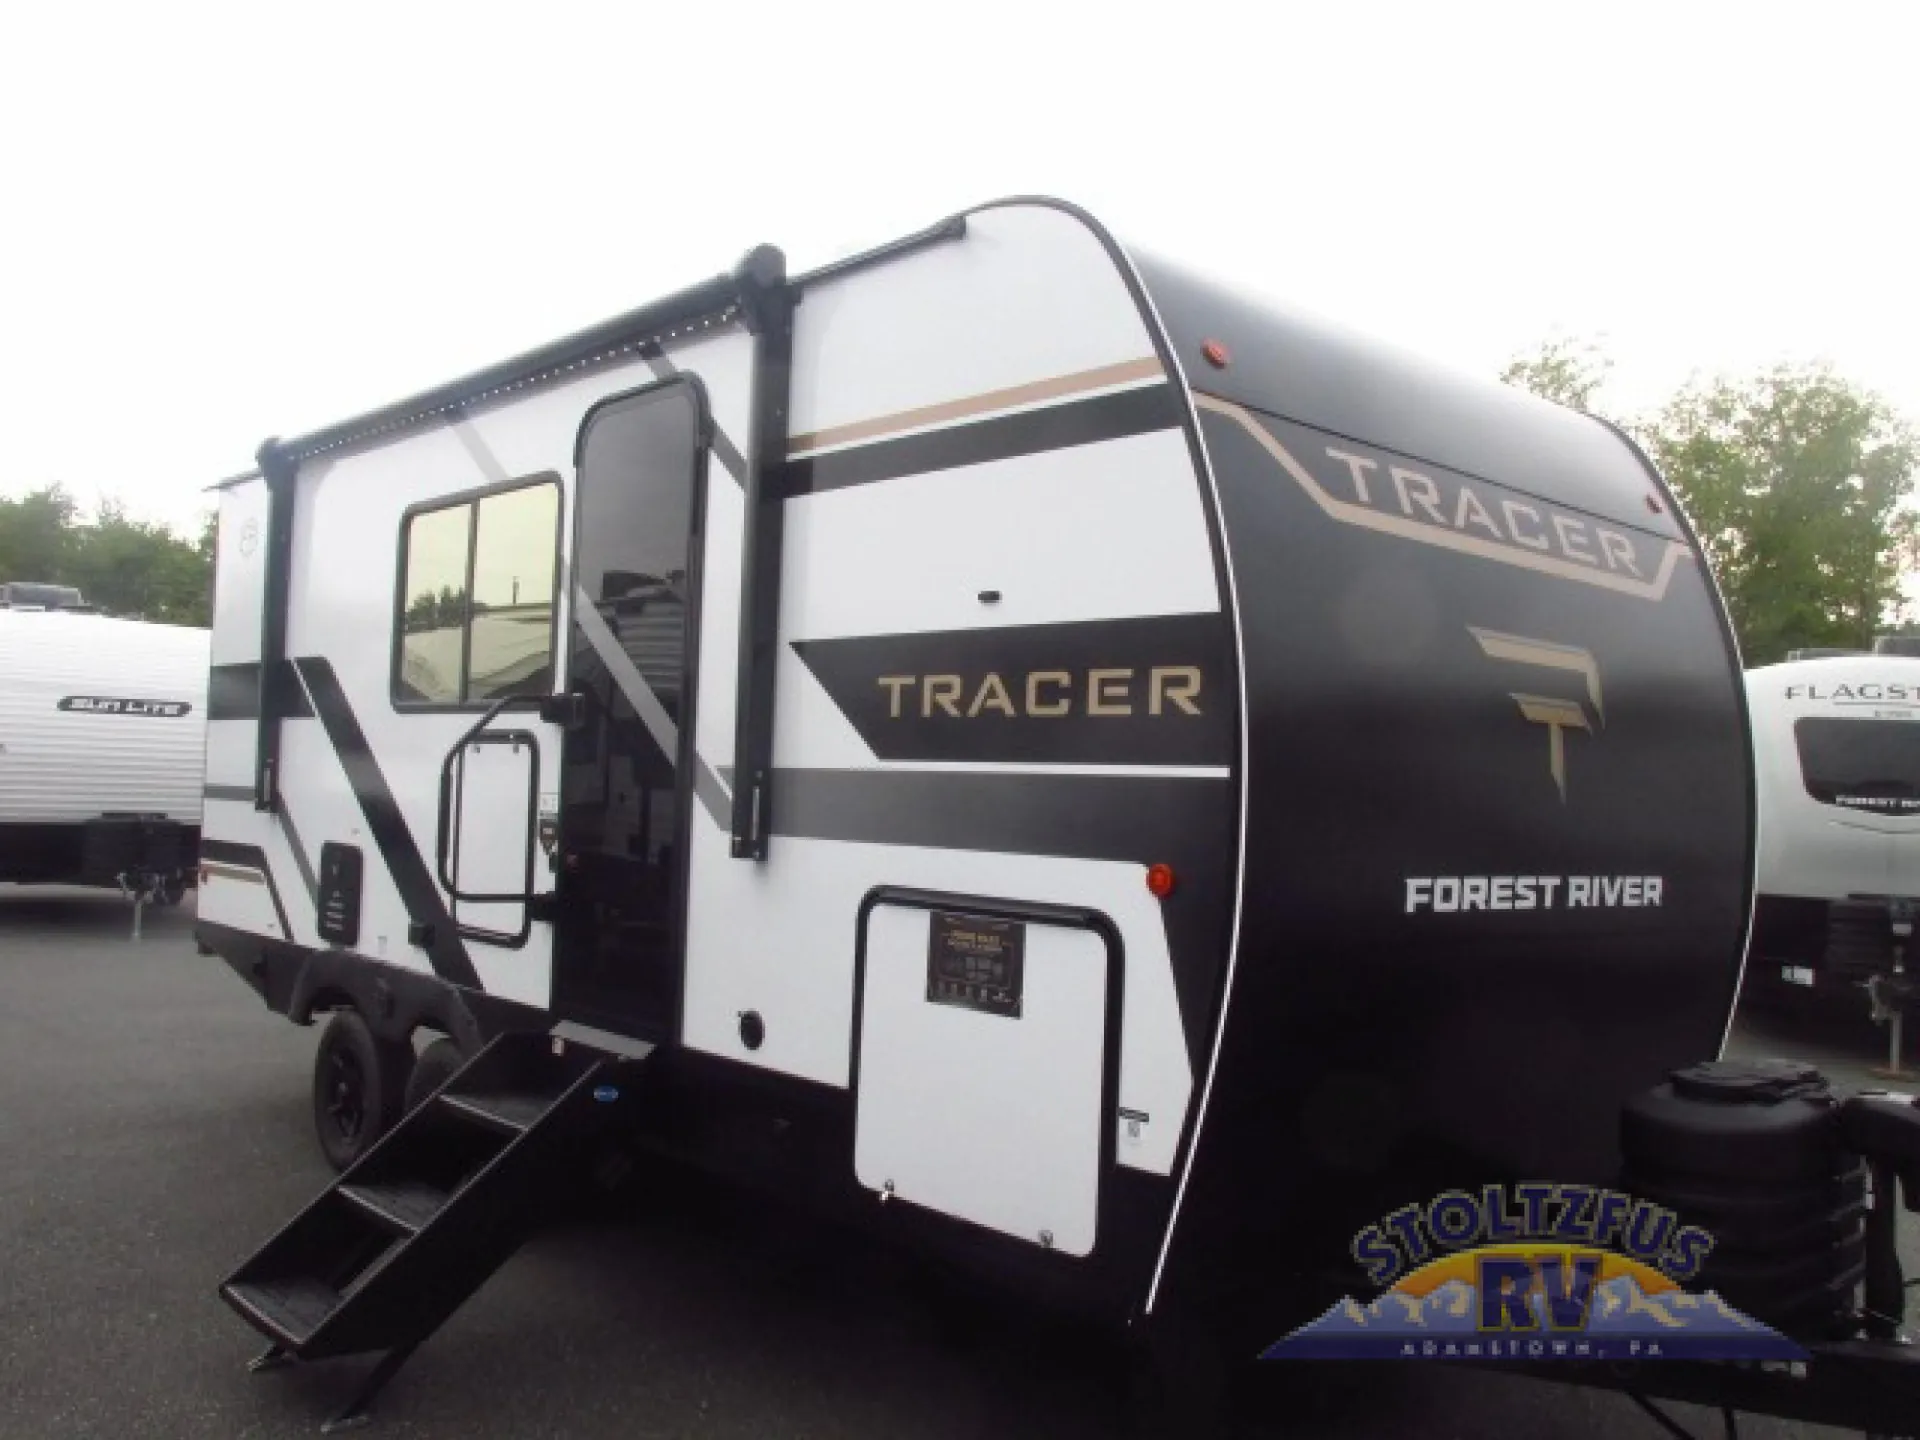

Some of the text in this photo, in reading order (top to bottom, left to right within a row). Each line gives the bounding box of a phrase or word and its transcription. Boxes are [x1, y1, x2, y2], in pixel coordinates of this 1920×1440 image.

[1325, 446, 1643, 578] TRACER
[877, 665, 1203, 718] TRACER
[1404, 875, 1664, 914] FOREST RIVER
